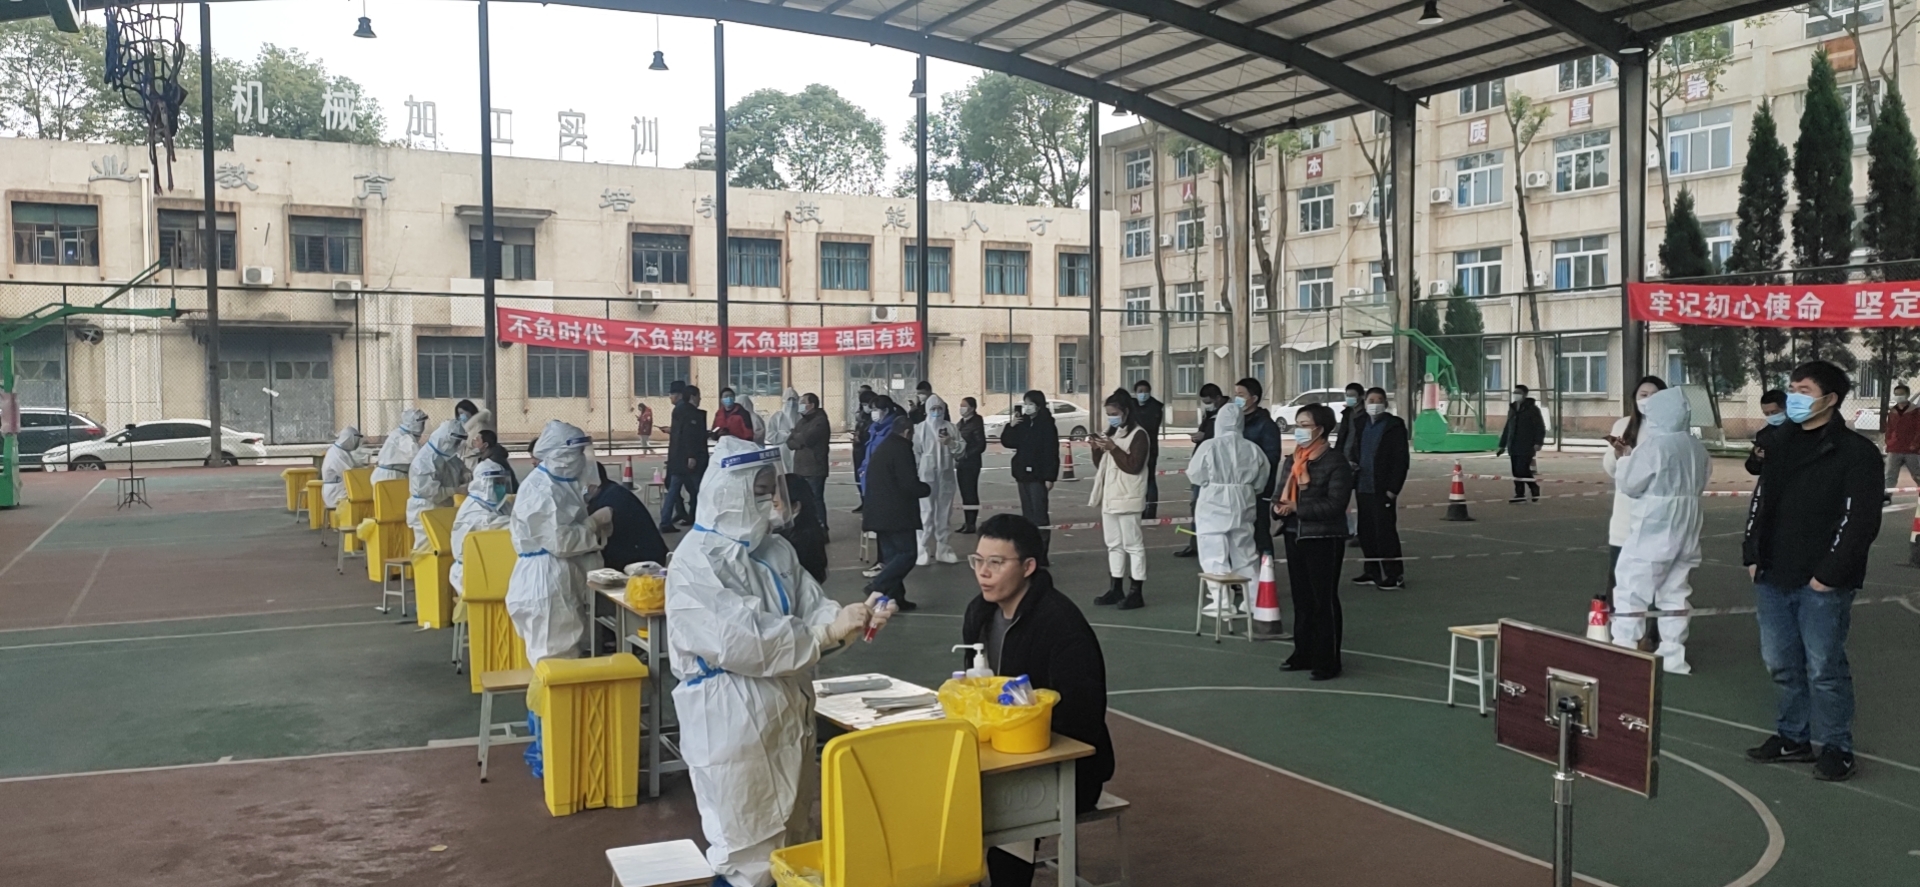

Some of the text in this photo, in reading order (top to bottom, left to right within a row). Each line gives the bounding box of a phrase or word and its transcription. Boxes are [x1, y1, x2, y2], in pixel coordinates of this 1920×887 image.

[231, 78, 717, 161] 机械加工实训室
[88, 154, 395, 200] 业教育
[1649, 288, 1920, 322] 牢记初心使命 坚定
[507, 313, 916, 354] 不负时代 不负韶华 不负期望 强国有我
